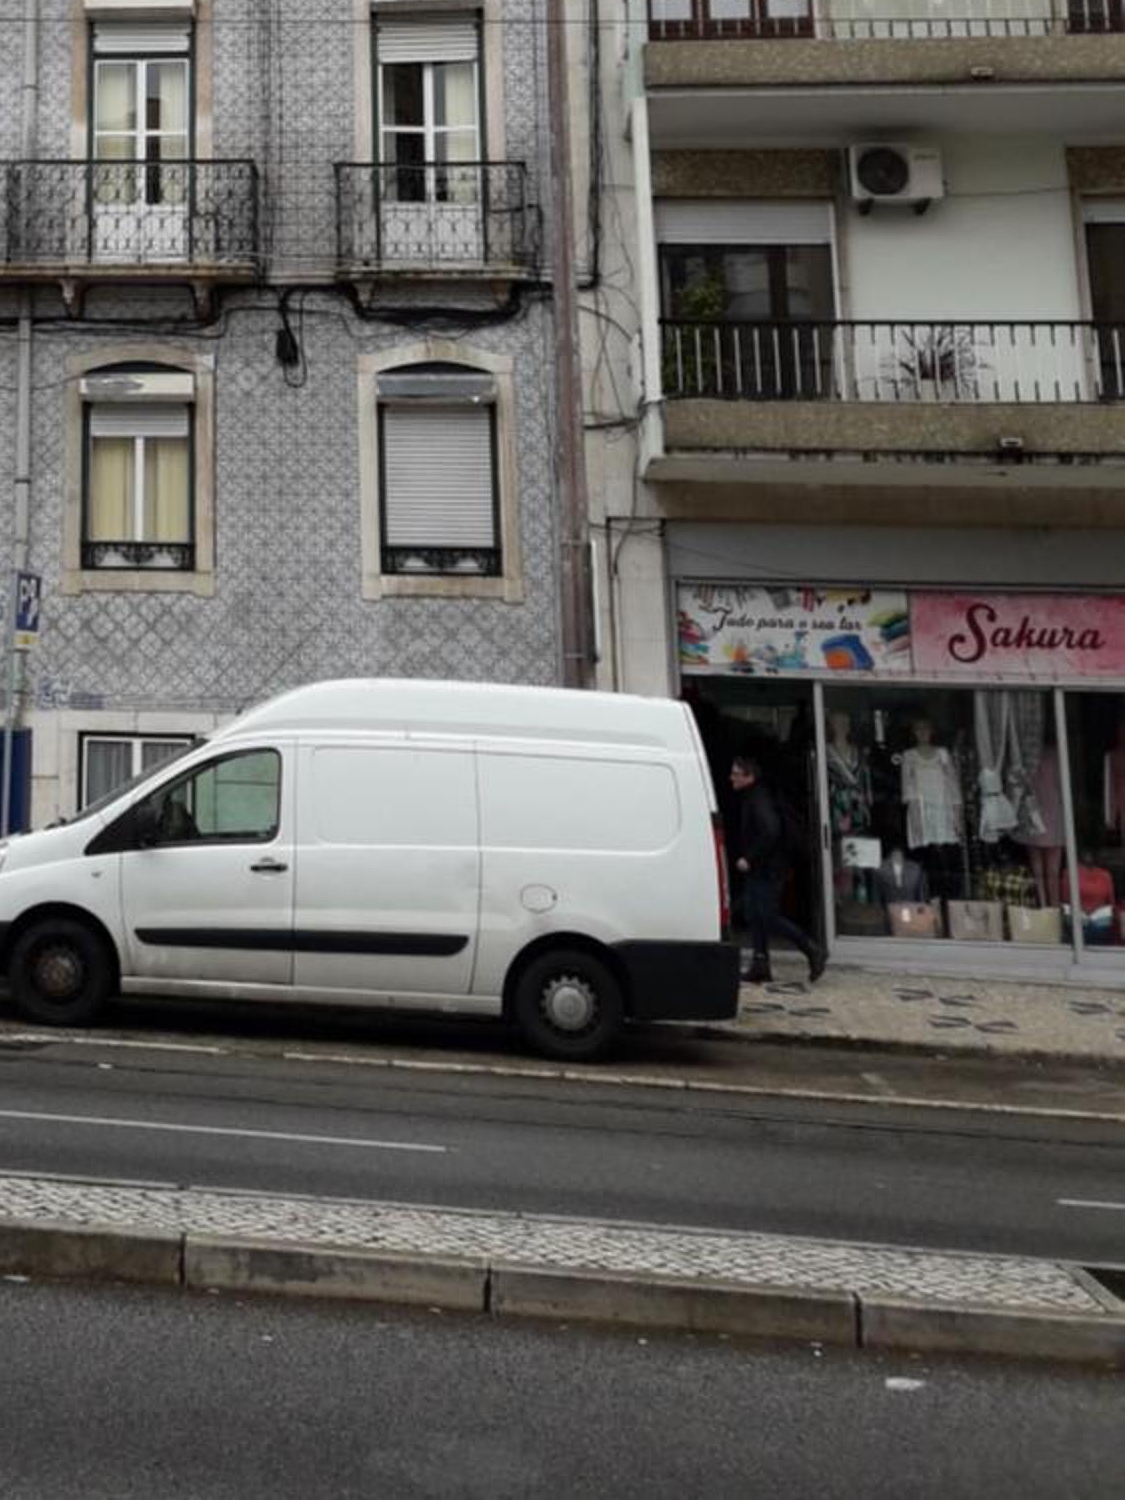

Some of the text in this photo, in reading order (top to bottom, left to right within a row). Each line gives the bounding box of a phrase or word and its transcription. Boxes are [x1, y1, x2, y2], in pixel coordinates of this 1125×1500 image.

[756, 616, 794, 631] para
[798, 618, 808, 628] o
[812, 617, 835, 630] seu
[839, 615, 862, 631] lar
[948, 603, 1106, 664] Sakura
